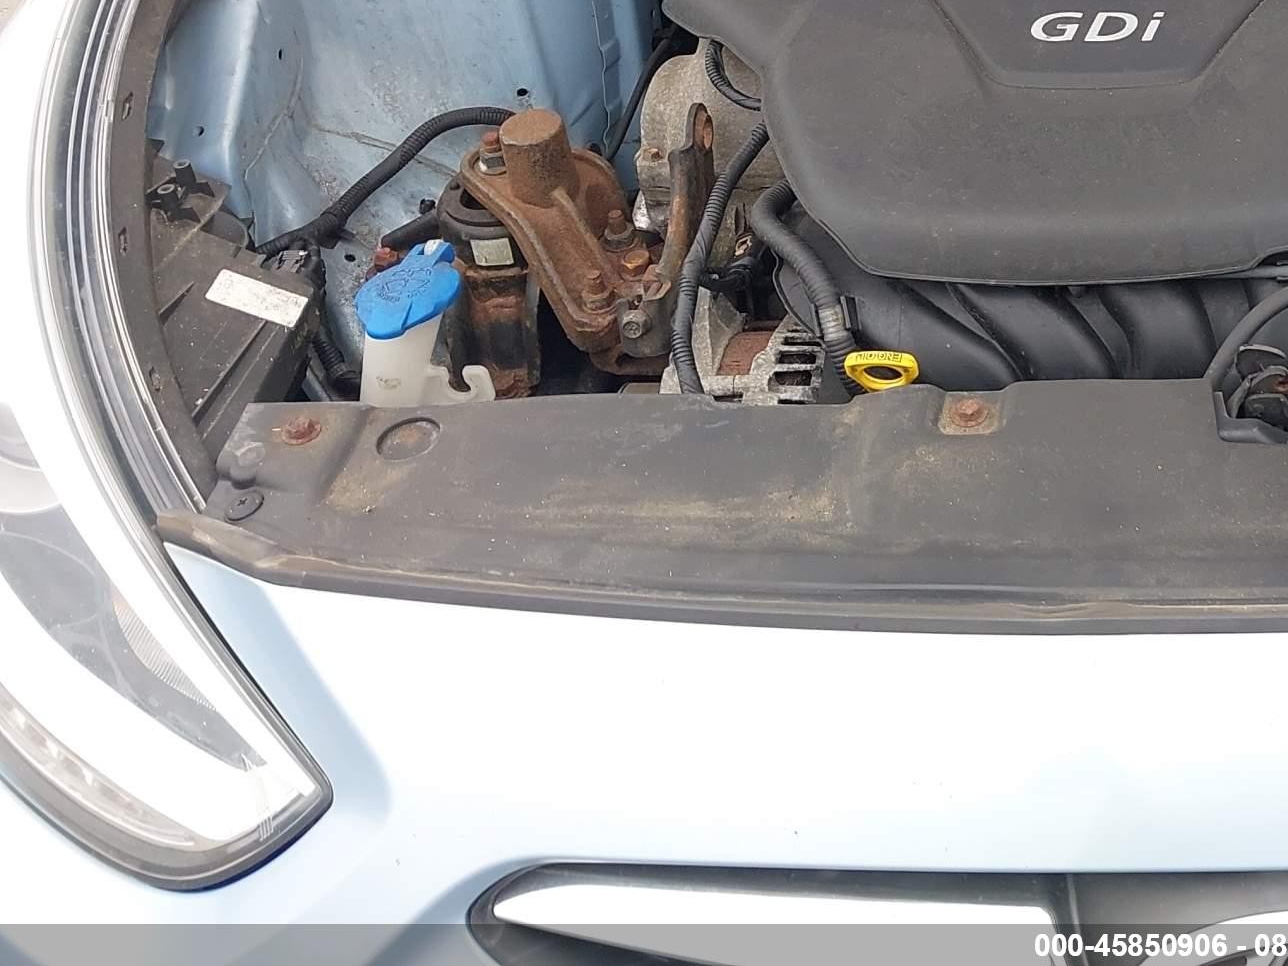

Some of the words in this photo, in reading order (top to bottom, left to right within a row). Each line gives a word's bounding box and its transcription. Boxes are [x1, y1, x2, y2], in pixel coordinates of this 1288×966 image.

[1030, 11, 1166, 42] GDi
[855, 352, 877, 362] OIL
[878, 353, 903, 363] ENG
